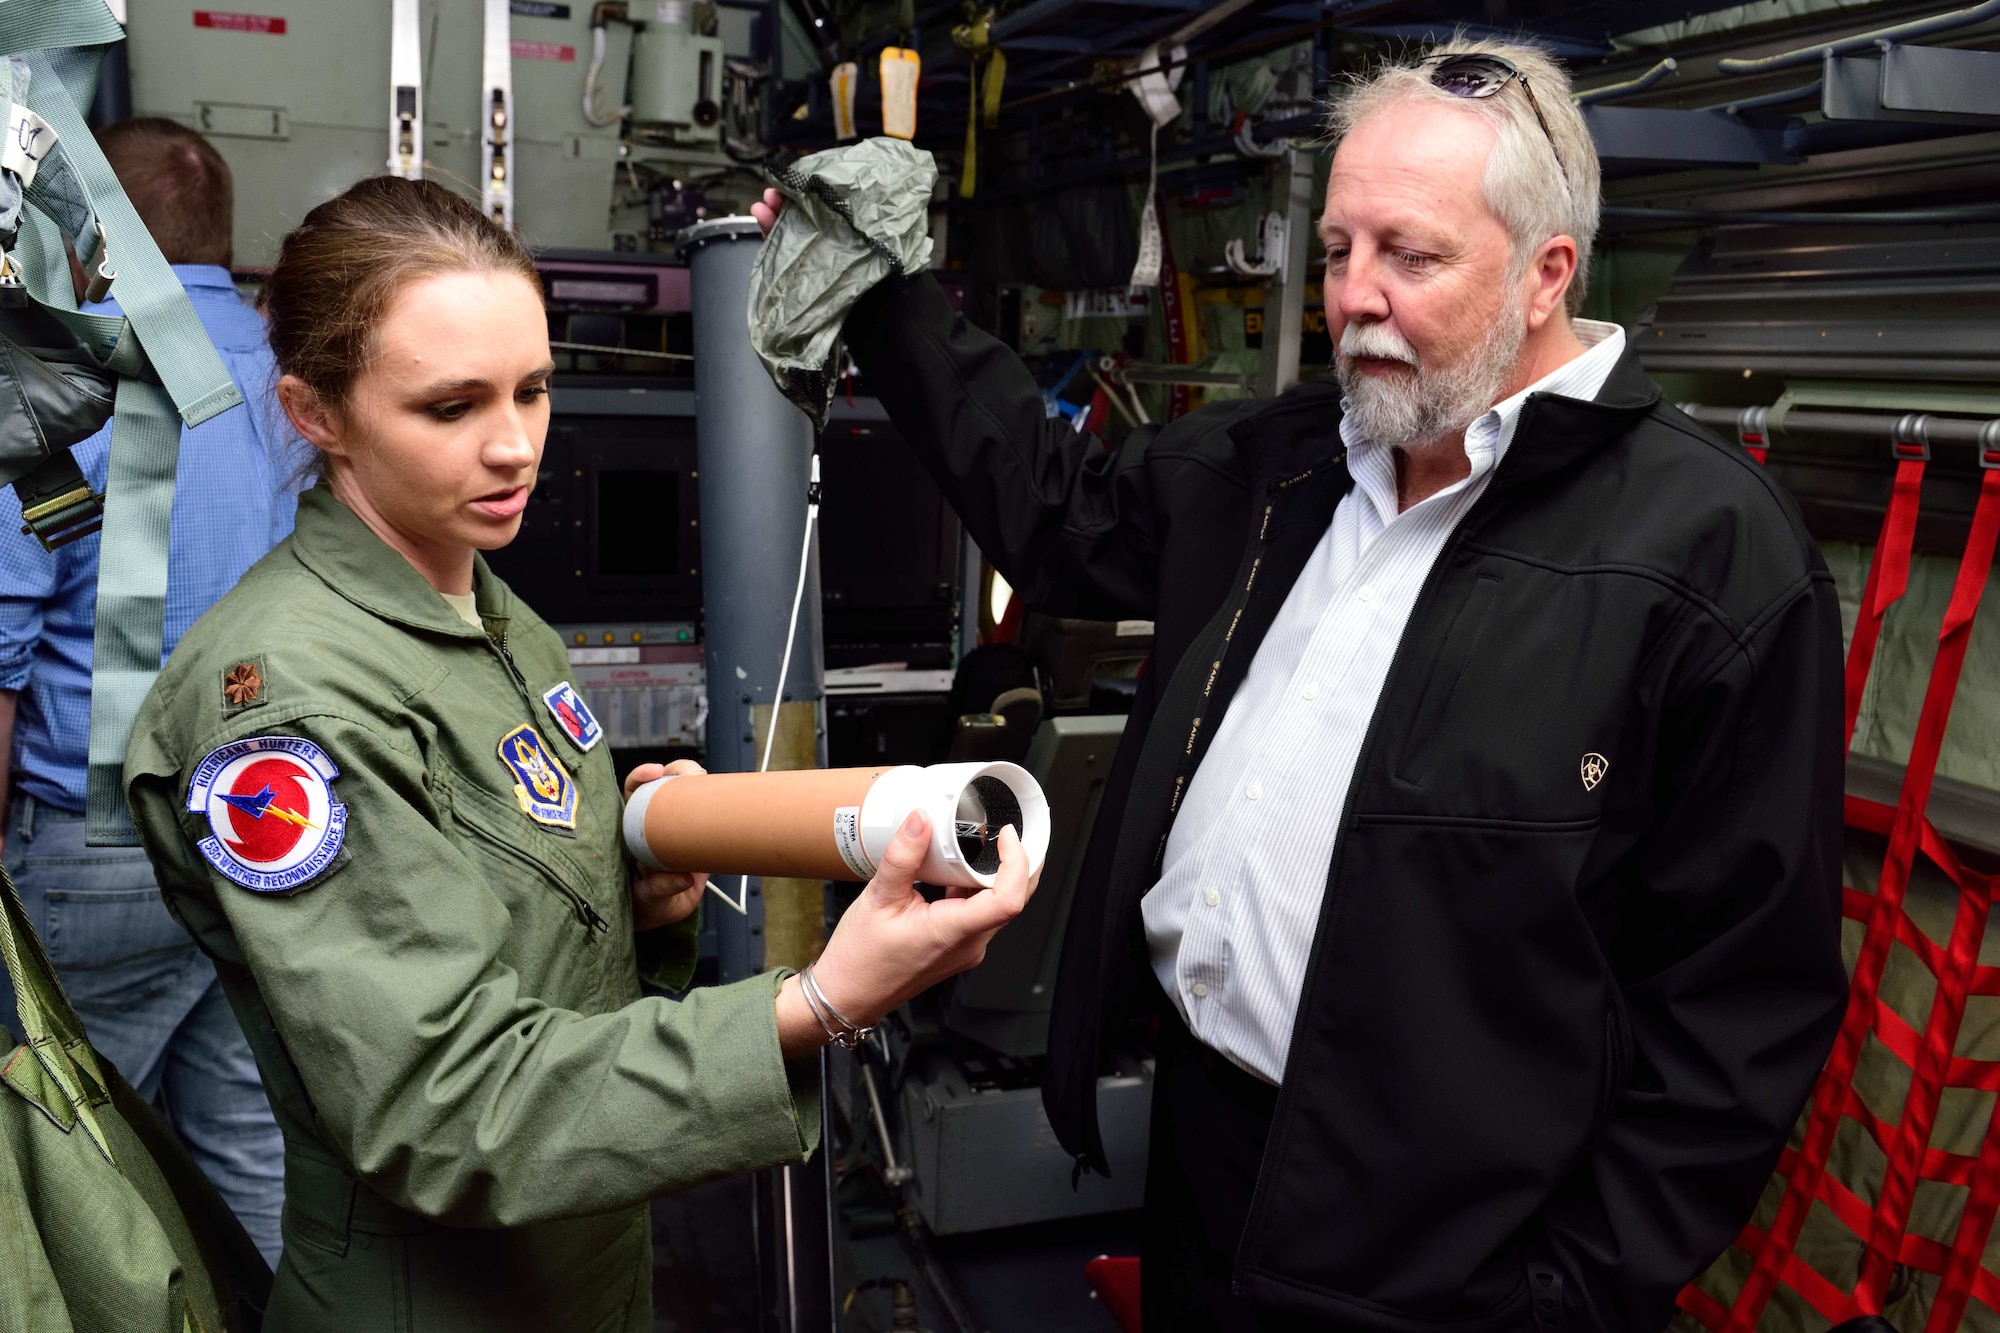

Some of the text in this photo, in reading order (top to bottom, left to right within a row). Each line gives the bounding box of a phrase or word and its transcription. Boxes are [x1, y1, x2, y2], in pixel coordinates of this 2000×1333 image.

[1288, 469, 1313, 485] ARIAT
[1203, 669, 1217, 697] ARIAT
[1185, 726, 1198, 756] ARIAT
[196, 739, 319, 788] HURRICANE HUNTERS
[1170, 784, 1181, 812] ARIAT
[218, 855, 263, 888] WEATHER
[263, 827, 342, 888] RECONNAISSANCE
